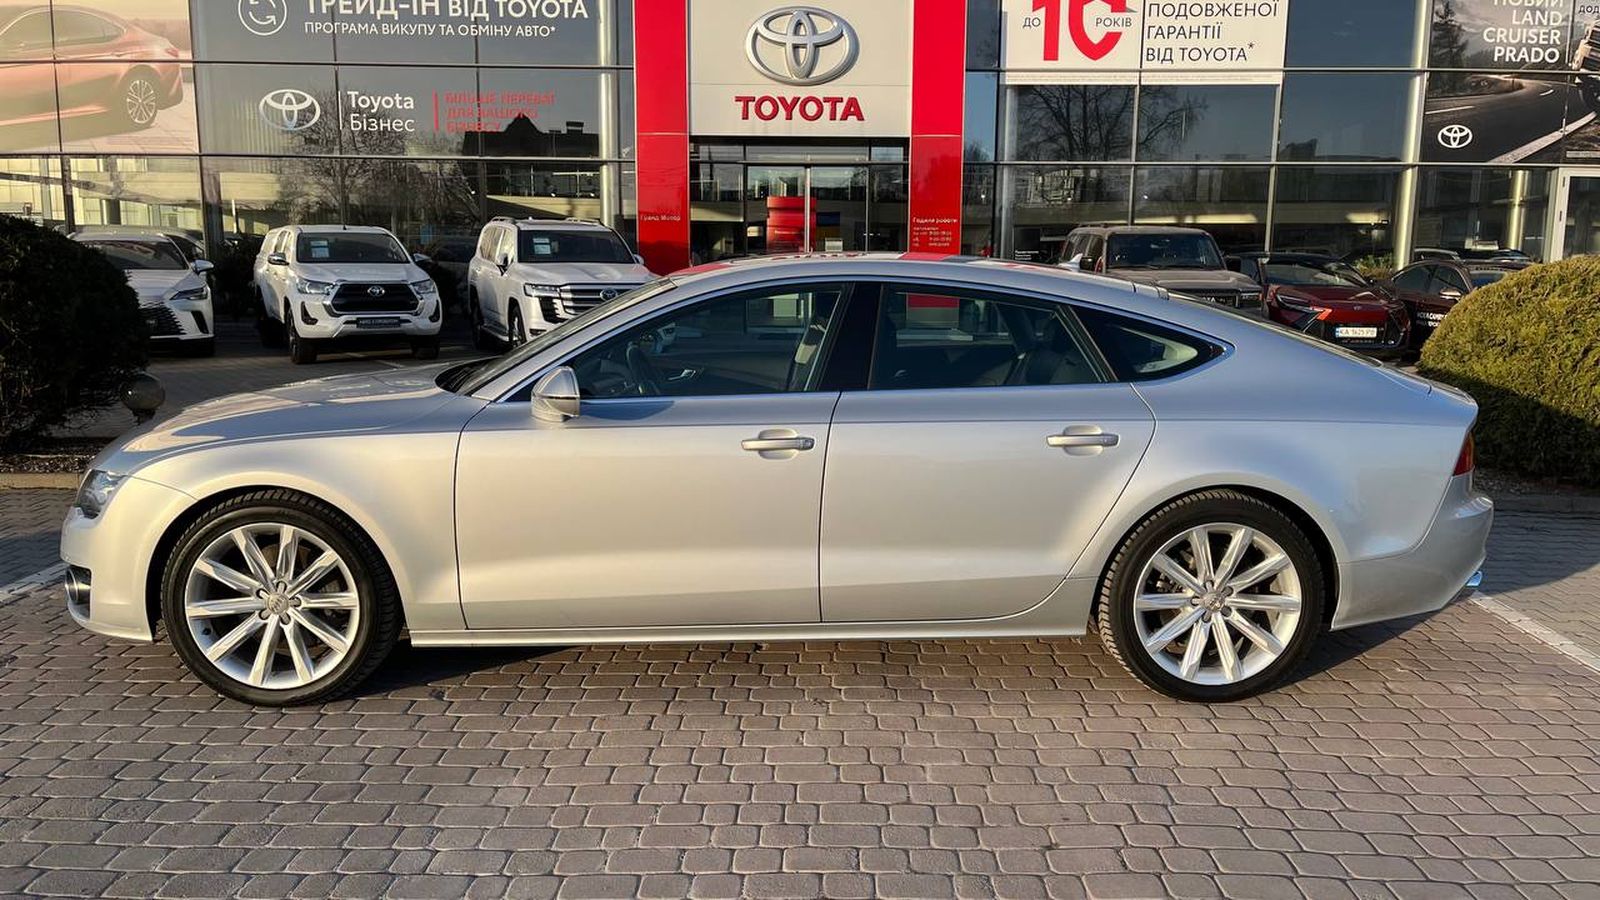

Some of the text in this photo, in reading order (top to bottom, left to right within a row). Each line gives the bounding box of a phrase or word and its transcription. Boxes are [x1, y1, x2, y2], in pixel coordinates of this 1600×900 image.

[448, 0, 490, 21] ВІД
[495, 0, 589, 18] TOYOTA
[1148, 0, 1280, 20] ПОДОВЖЕНОЇ
[1512, 9, 1563, 26] LAND
[304, 22, 379, 35] ПРОГРАМА
[381, 23, 437, 36] ВИКУПУ
[439, 24, 455, 36] ТА
[457, 24, 513, 37] ОБМІНУ
[1022, 17, 1041, 28] ДО
[1095, 17, 1132, 28] РОКІВ
[1147, 21, 1223, 39] ГАРАНТІЇ
[1483, 27, 1561, 45] CRUISER
[1146, 47, 1174, 64] ВІД
[1493, 46, 1560, 63] PRADO
[347, 91, 415, 112] Toyota
[734, 95, 865, 121] TOYOTA
[350, 113, 416, 132] Бізнес
